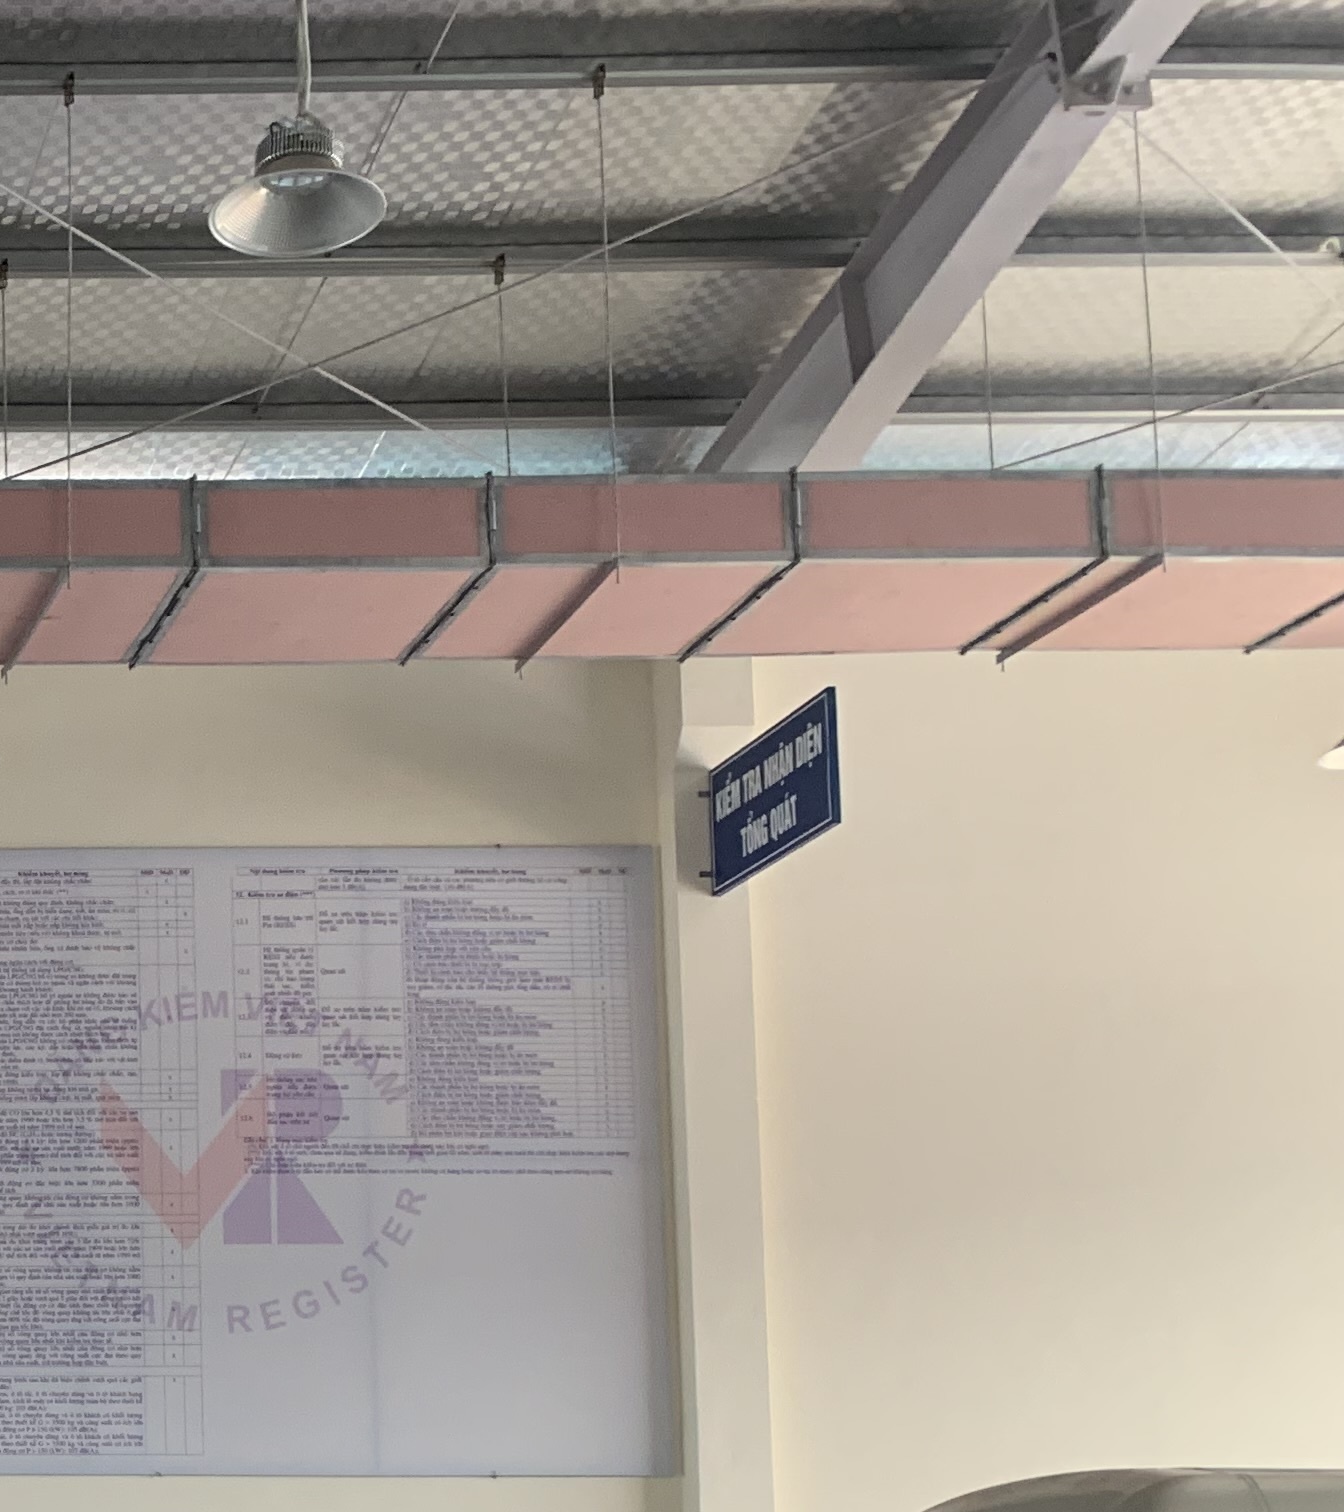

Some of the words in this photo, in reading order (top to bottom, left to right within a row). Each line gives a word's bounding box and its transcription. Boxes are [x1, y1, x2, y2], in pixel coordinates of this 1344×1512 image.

[715, 771, 742, 823] KIỂM
[742, 764, 762, 804] TRA
[740, 810, 769, 858] TỔNG
[770, 791, 797, 841] QUÁT
[226, 1187, 428, 1335] REGISTER
